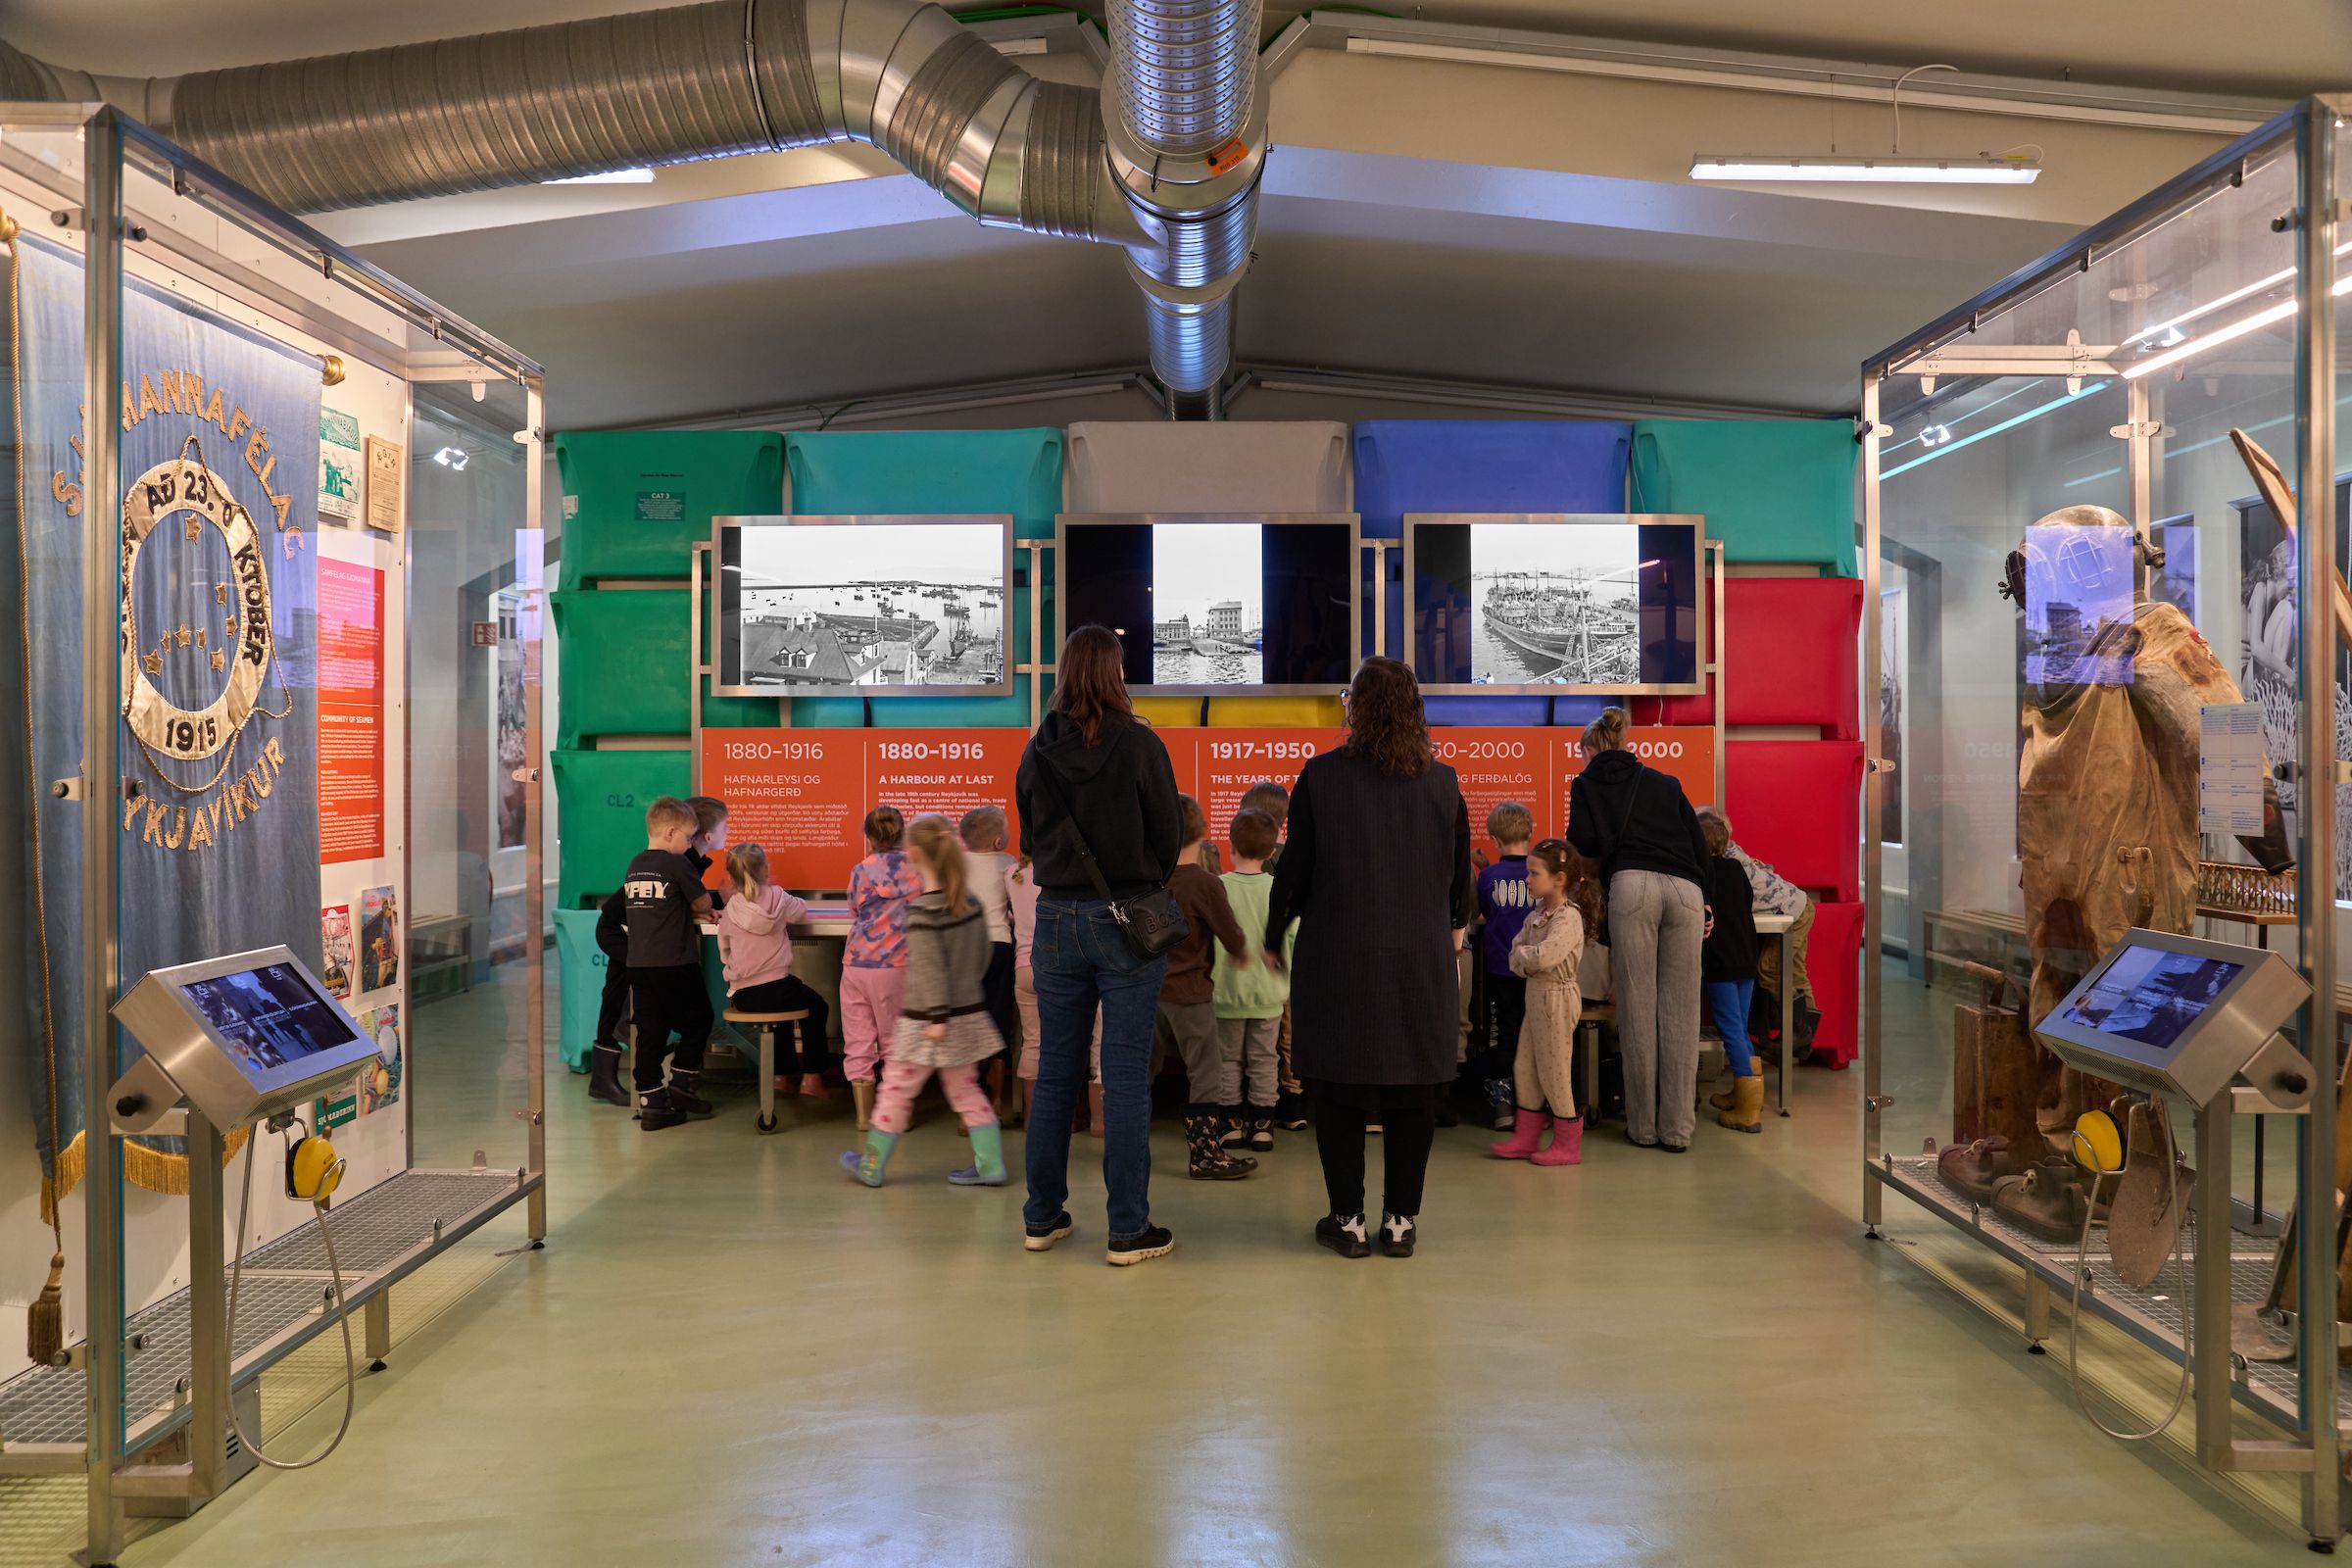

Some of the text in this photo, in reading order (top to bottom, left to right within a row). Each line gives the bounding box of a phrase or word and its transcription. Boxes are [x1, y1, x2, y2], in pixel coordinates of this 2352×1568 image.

[52, 368, 305, 560] SMANNAFÉLAG
[166, 717, 217, 752] 1915
[724, 743, 823, 760] 1880–1916
[879, 743, 984, 760] 1880–1916
[1210, 742, 1316, 760] 1917–1950
[1430, 742, 1525, 759] 50–2000
[1564, 741, 1684, 759] 192000
[724, 775, 820, 784] HAFNARLEYSI OG
[879, 775, 994, 784] A HARBOUR AT LAST
[1210, 775, 1233, 784] THE
[1235, 775, 1272, 784] YEARS
[1274, 775, 1290, 784] OF
[1472, 772, 1533, 784] FERÐALÖG
[724, 787, 802, 797] HAFNARGERÐ
[607, 795, 635, 808] CL2
[592, 955, 608, 966] CL
